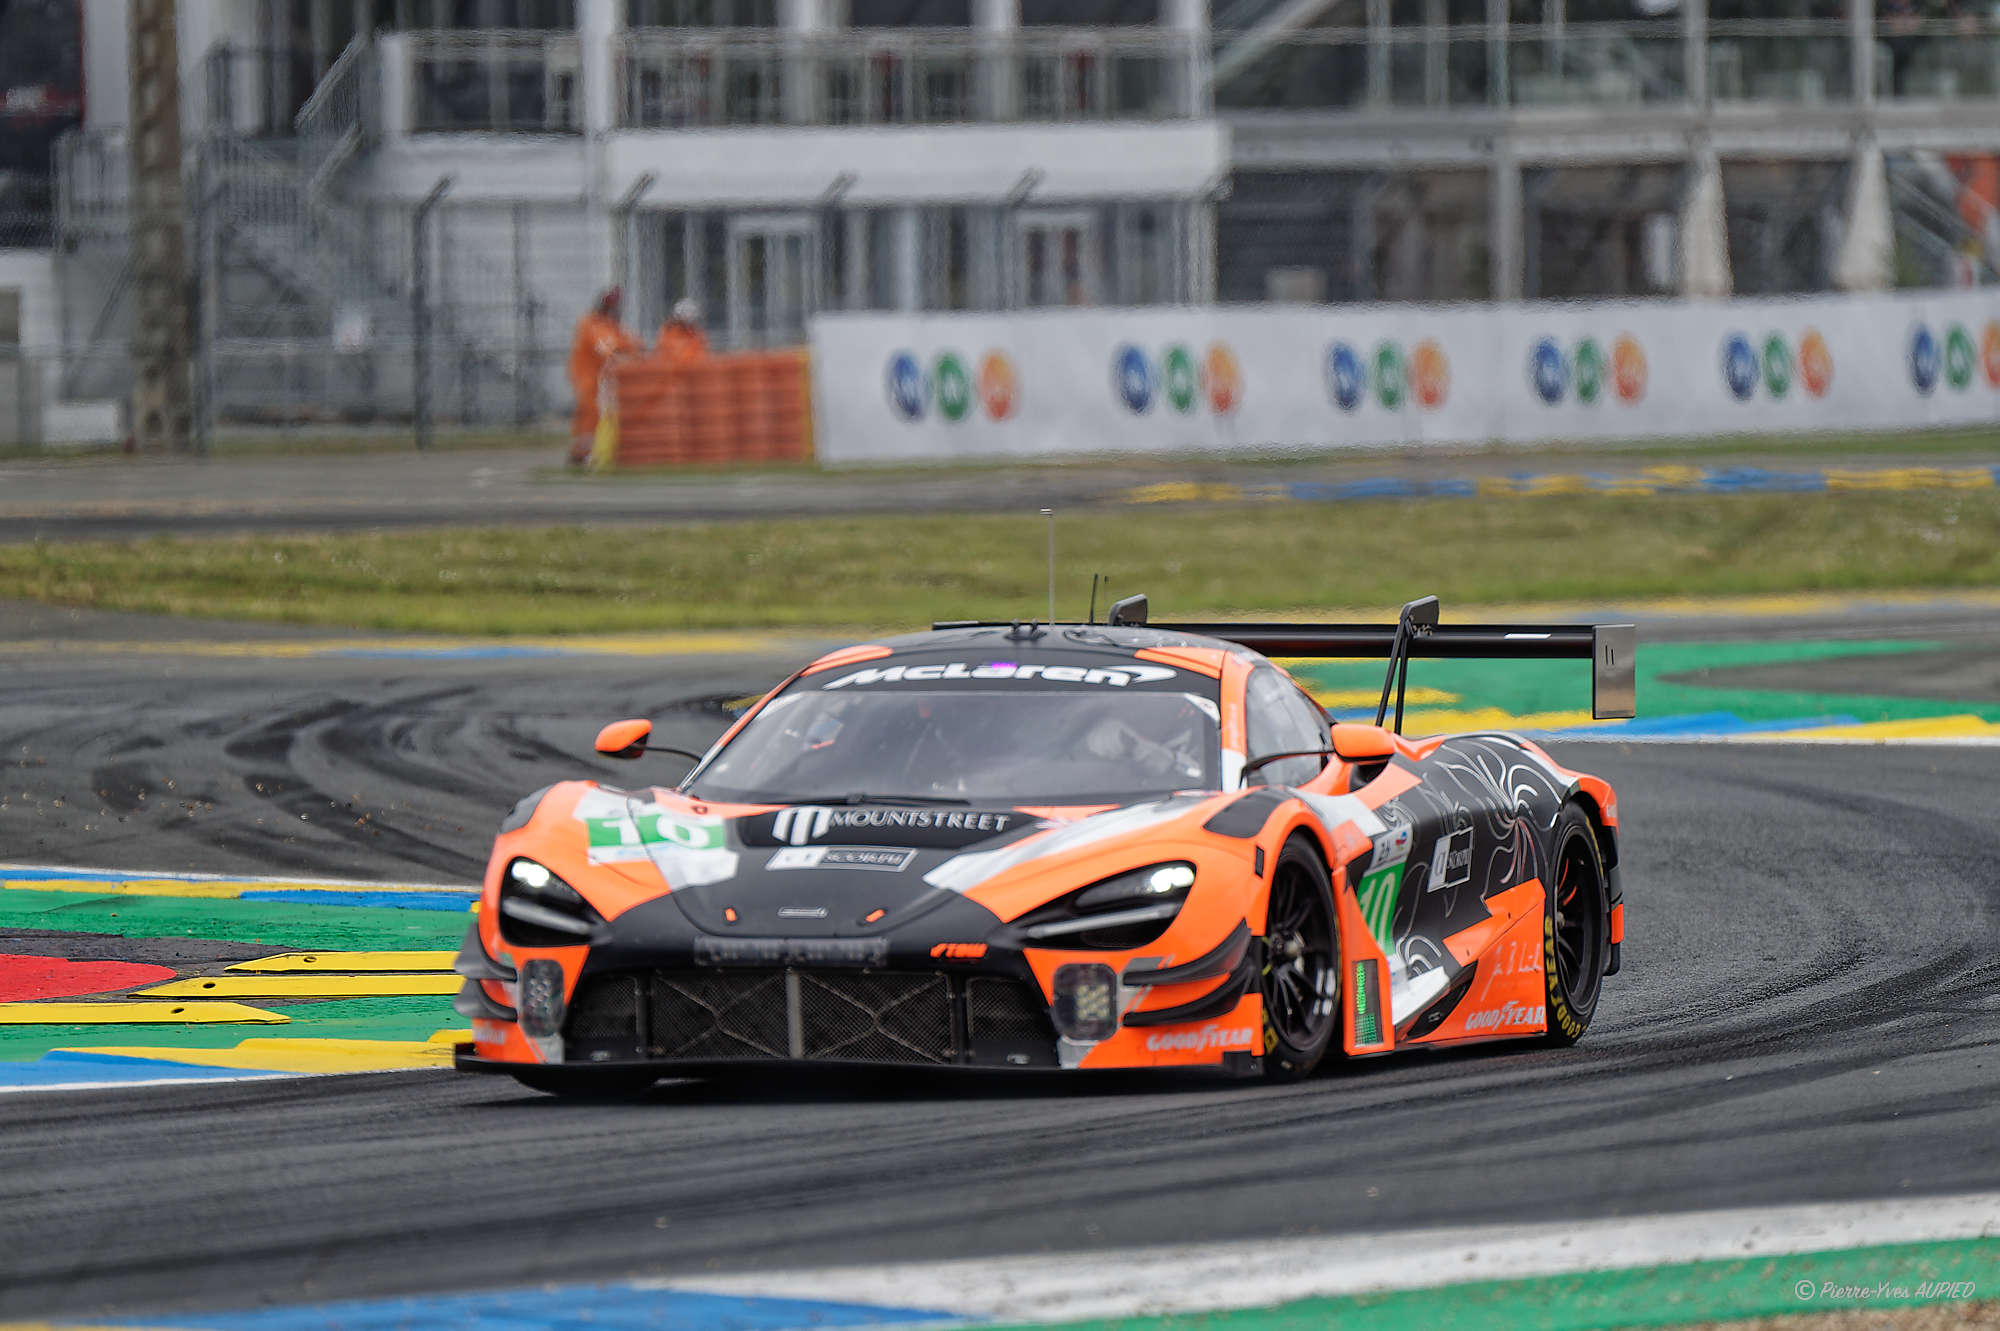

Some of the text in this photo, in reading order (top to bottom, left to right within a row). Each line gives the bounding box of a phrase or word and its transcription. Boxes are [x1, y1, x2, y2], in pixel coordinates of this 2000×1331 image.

[823, 663, 1150, 687] McLaren
[602, 815, 710, 849] 10
[830, 808, 1011, 832] MOUNTSTREET
[1359, 871, 1396, 951] 10
[1465, 1000, 1545, 1031] GOODYEAR
